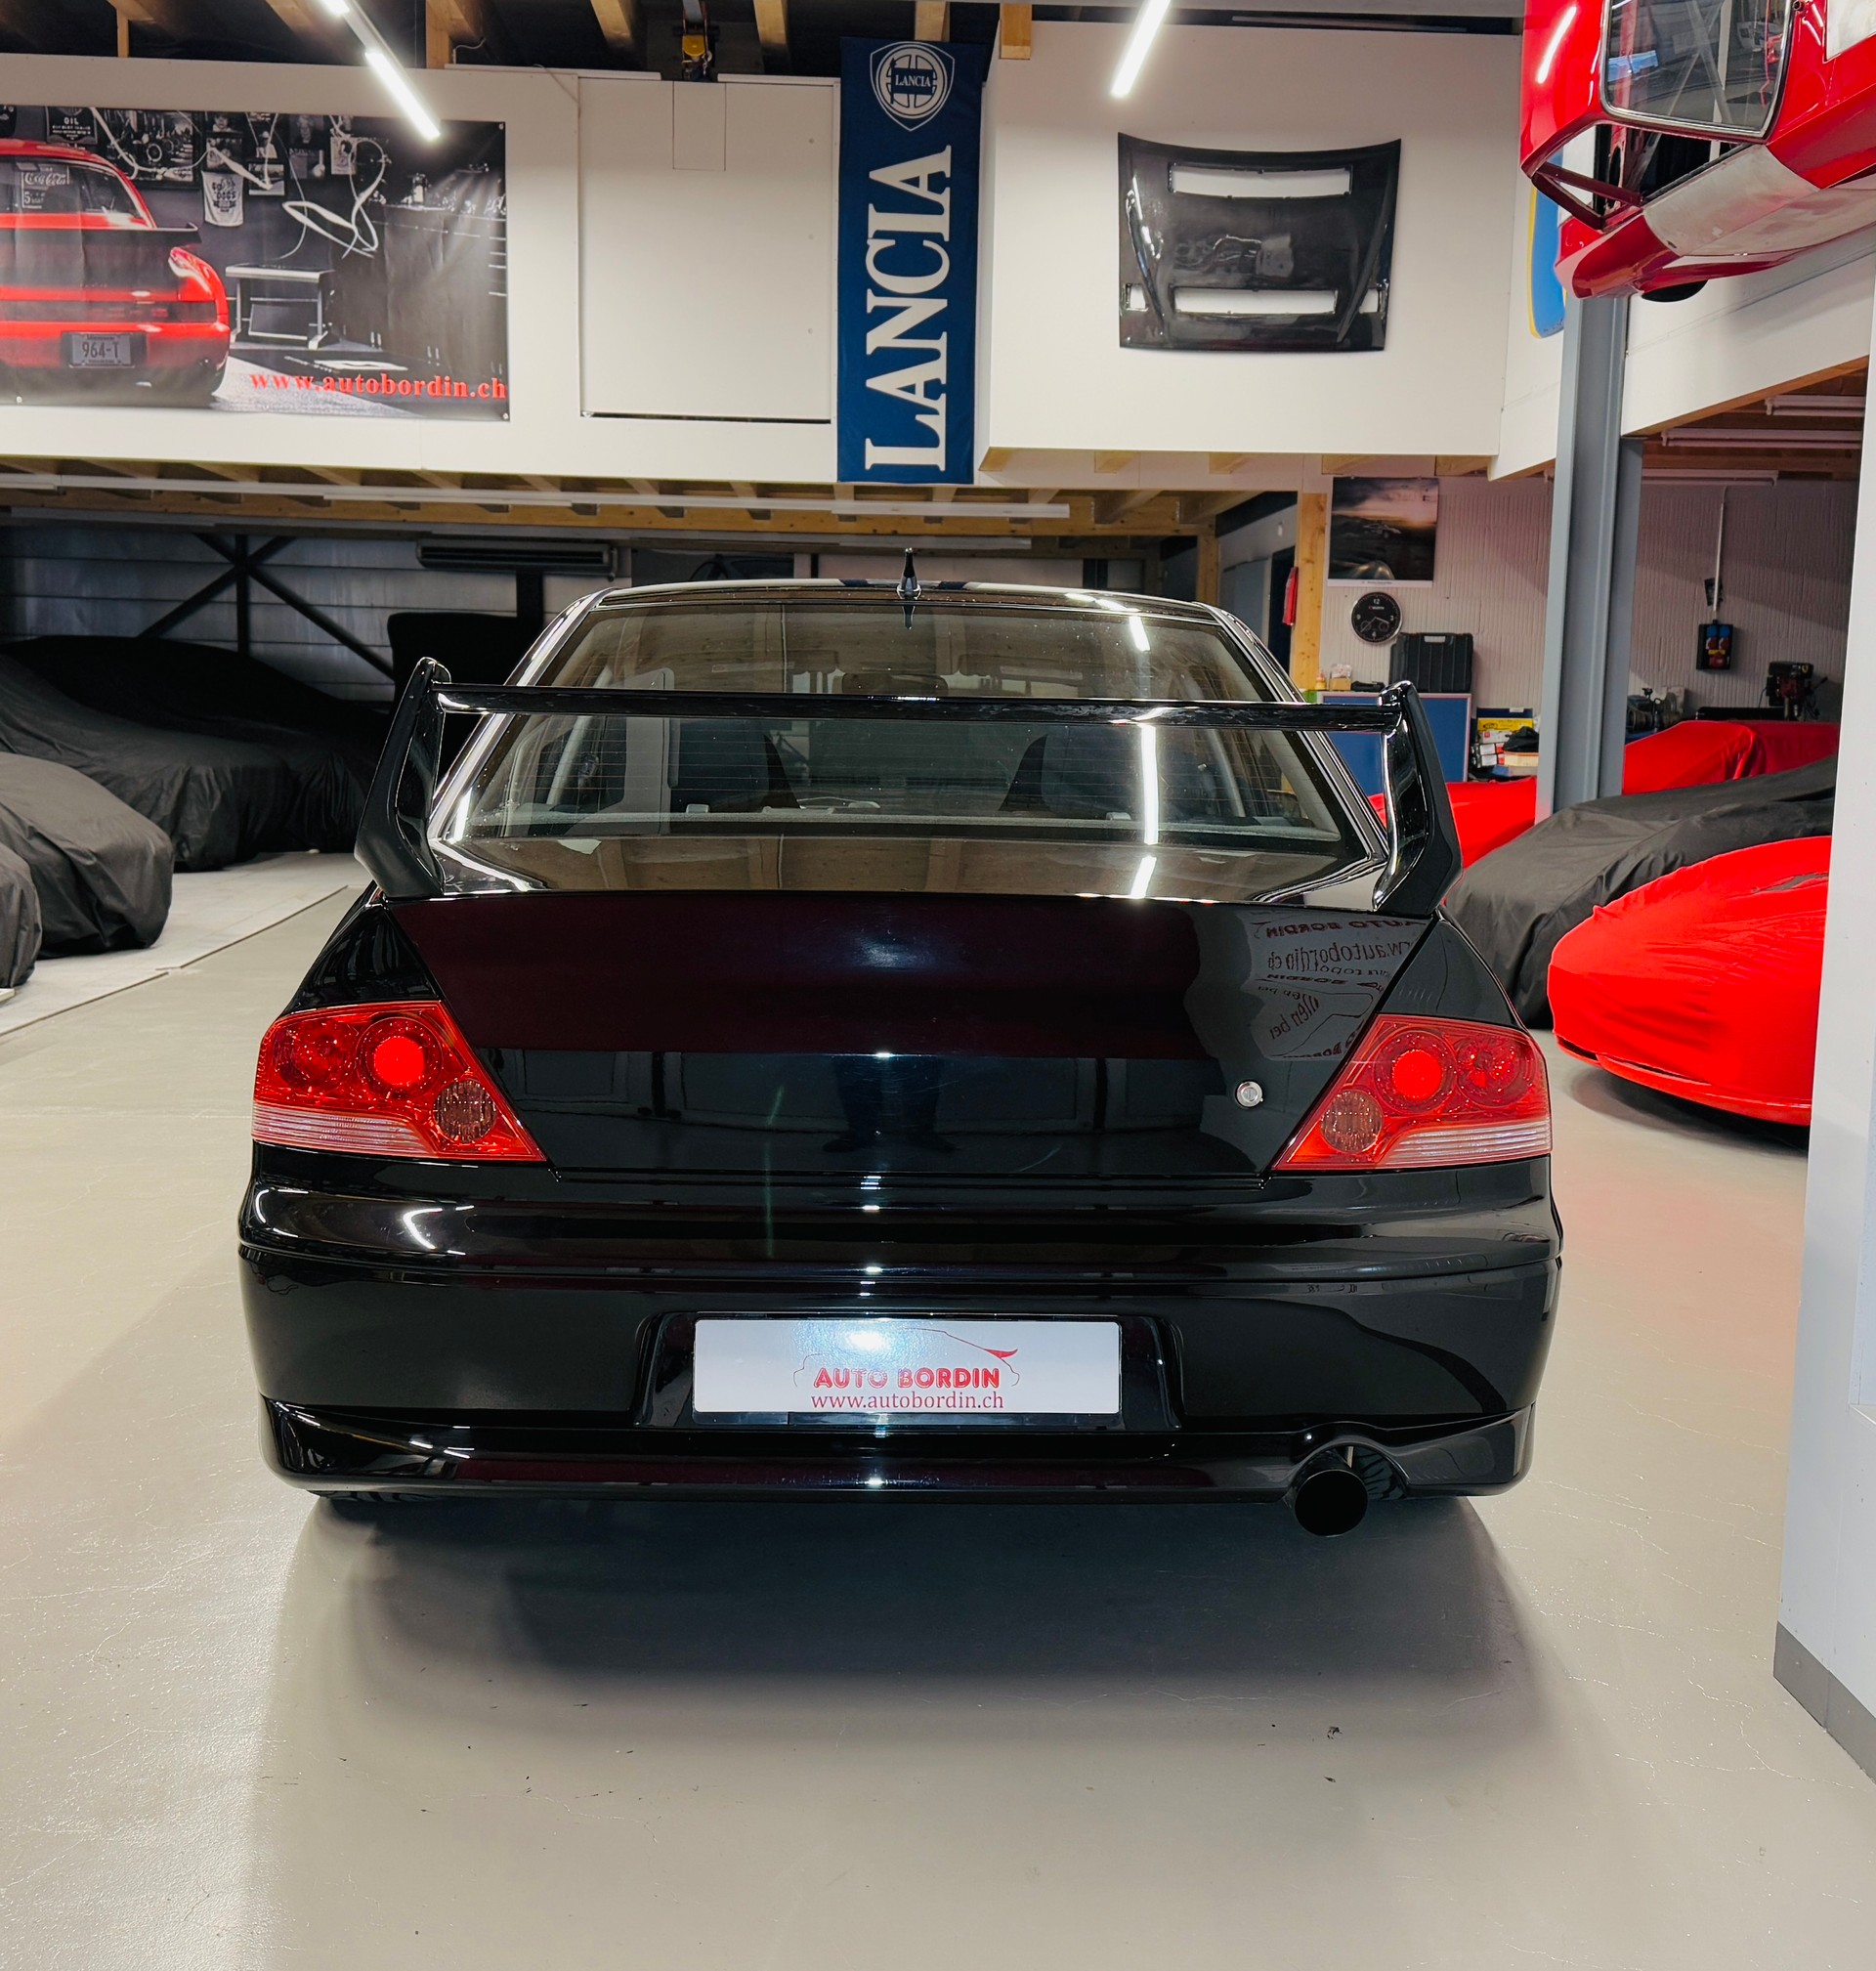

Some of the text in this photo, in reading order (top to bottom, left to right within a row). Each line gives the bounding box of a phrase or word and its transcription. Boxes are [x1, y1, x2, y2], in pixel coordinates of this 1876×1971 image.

[895, 74, 931, 87] LANCIA
[64, 116, 79, 125] OIL
[865, 145, 952, 472] LANCIA
[82, 341, 119, 359] 964-T
[250, 371, 507, 400] www.autobordin.ch
[814, 1367, 1001, 1389] AUTO BORDIN
[811, 1391, 1004, 1408] www.autobordin.ch
